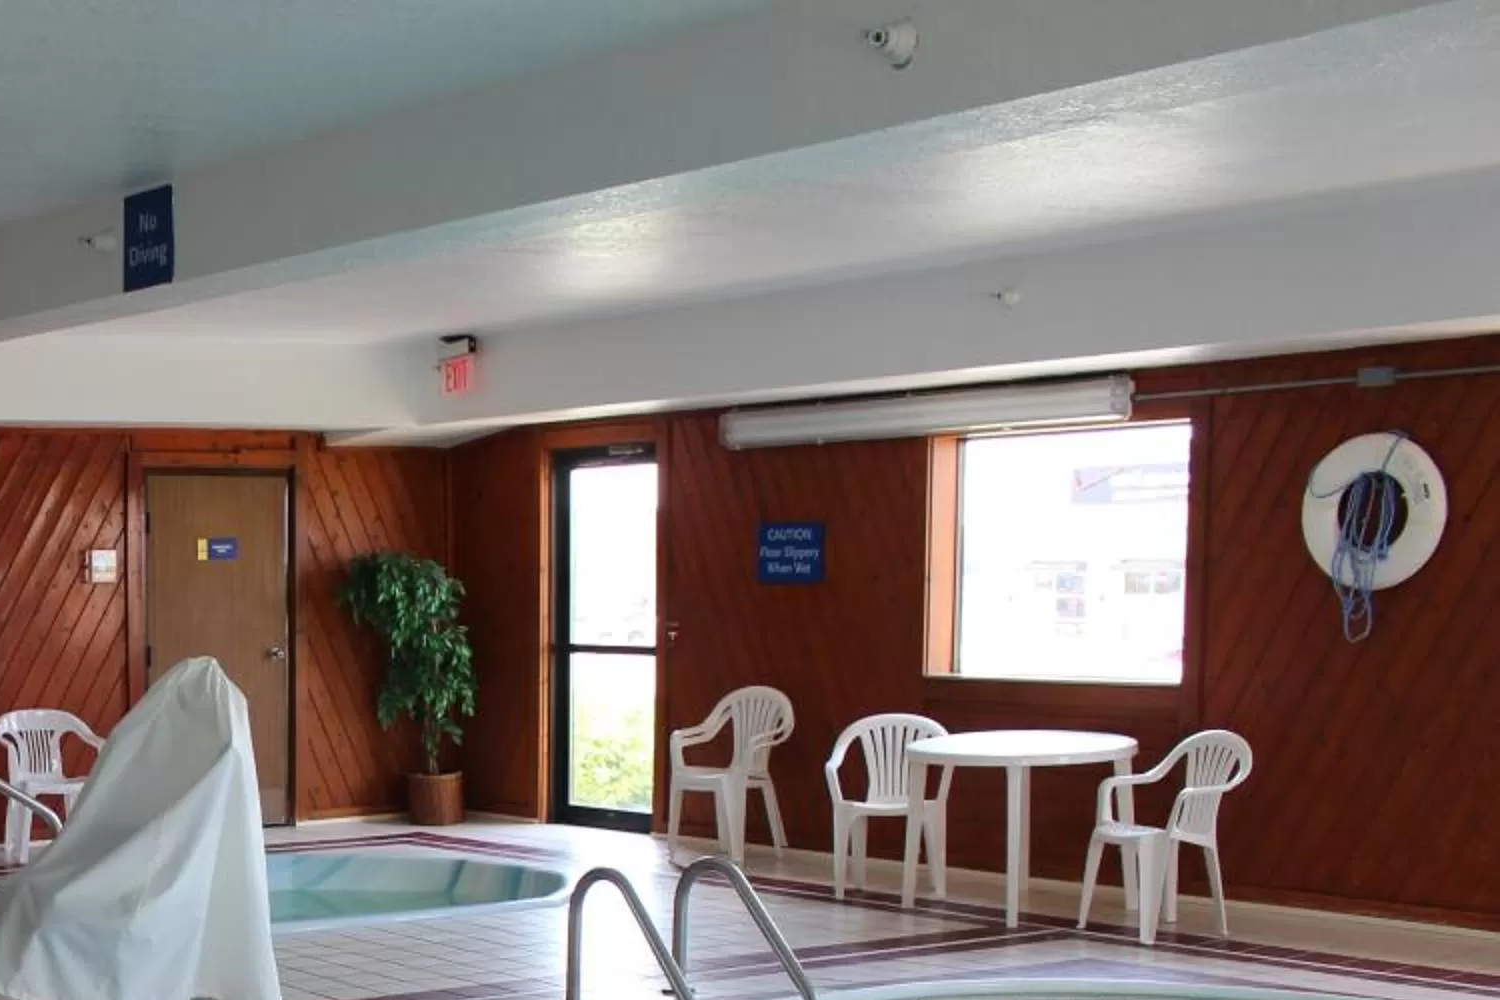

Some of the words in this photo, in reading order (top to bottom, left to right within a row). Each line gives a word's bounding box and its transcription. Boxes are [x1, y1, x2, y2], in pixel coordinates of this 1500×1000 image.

[139, 211, 157, 233] No
[128, 242, 167, 268] Diving
[445, 358, 468, 393] EXIT
[767, 528, 812, 541] CAUTION
[783, 545, 820, 561] Slippery
[767, 562, 793, 574] When
